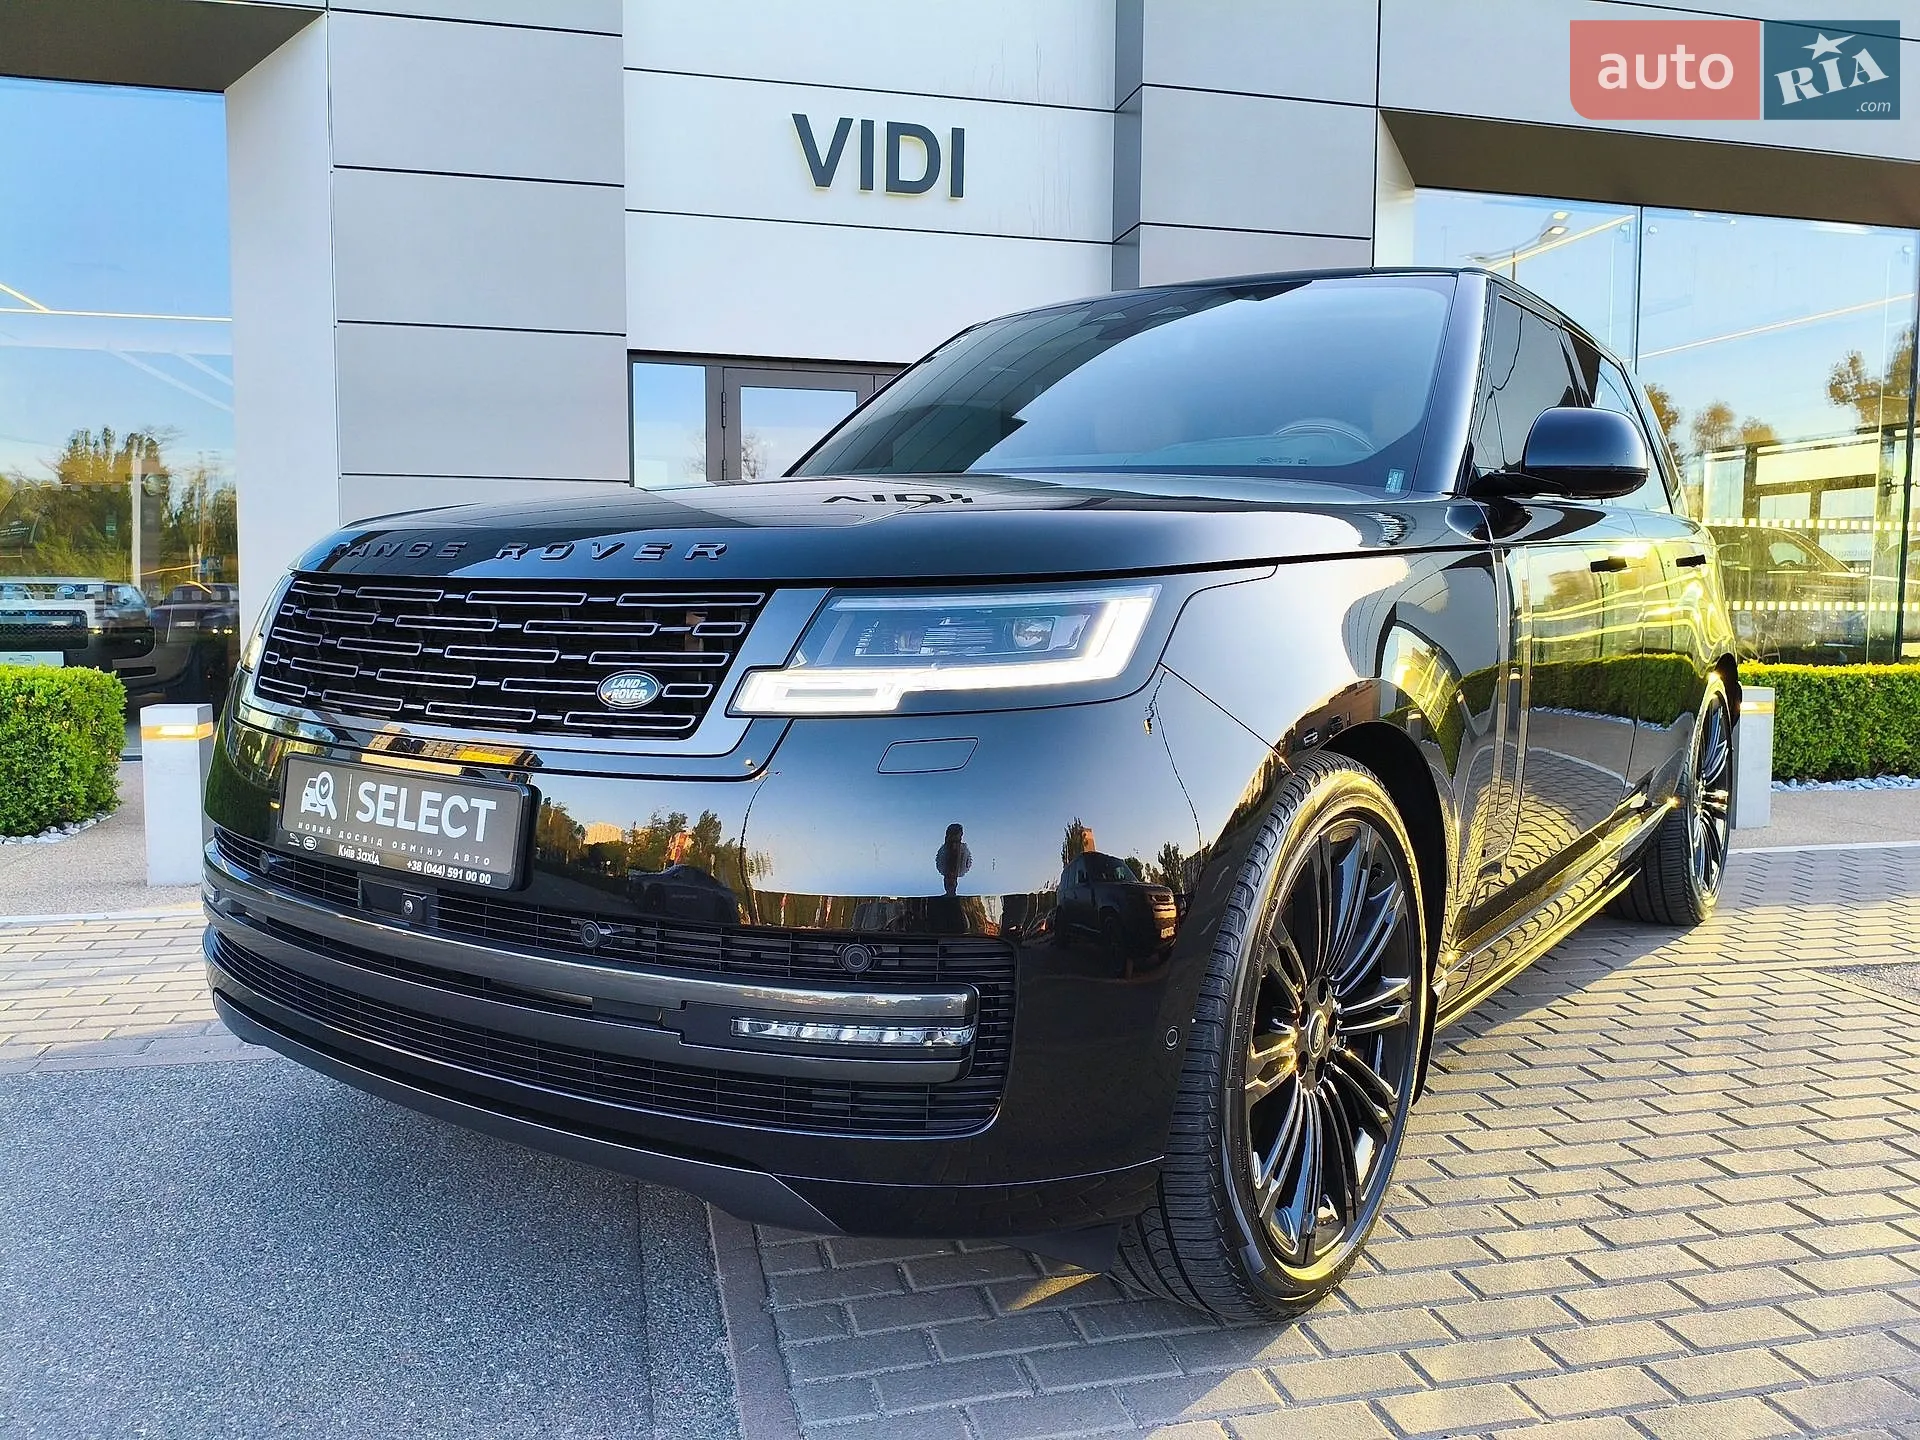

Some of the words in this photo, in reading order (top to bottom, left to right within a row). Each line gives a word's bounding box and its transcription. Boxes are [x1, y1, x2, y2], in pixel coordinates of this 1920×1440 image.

[792, 113, 965, 198] VIDI
[495, 541, 729, 561] ROVER
[355, 781, 497, 842] SELECT
[298, 821, 332, 835] НОВИЙ
[338, 830, 383, 847] ДОСВІД
[391, 840, 443, 857] ОБМІНУ
[453, 852, 491, 866] АВТО
[338, 844, 356, 859] Київ
[356, 848, 380, 866] Захід
[407, 860, 422, 872] +38
[423, 861, 446, 877] (044)
[447, 867, 463, 880] 591
[465, 870, 477, 882] 00
[479, 873, 491, 885] 00
